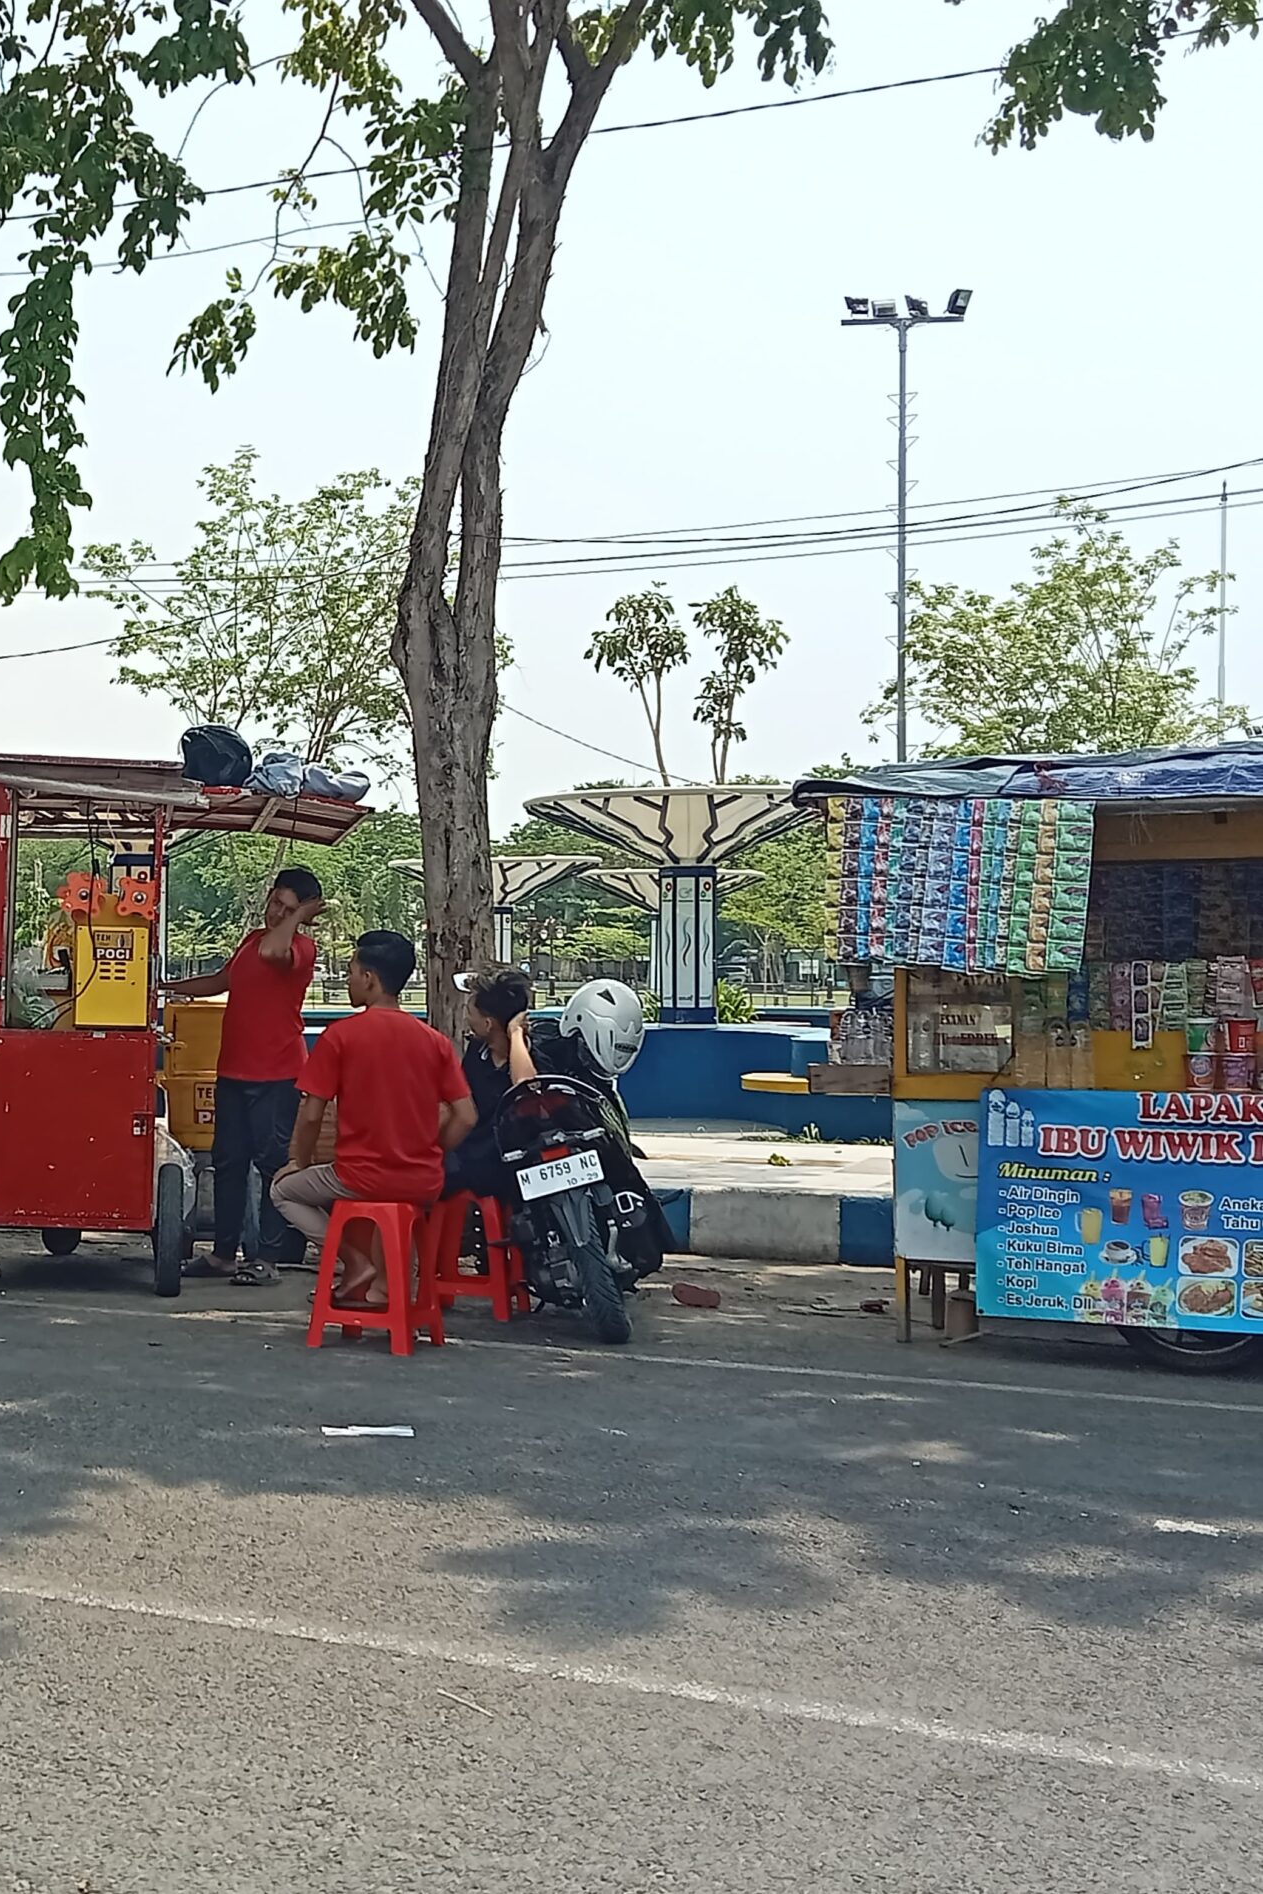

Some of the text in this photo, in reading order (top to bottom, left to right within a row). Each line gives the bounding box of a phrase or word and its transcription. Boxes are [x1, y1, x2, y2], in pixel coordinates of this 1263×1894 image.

[96, 933, 111, 942] TEH
[96, 948, 130, 960] POCI
[197, 1086, 216, 1099] TE
[1138, 1091, 1263, 1123] LAPAK
[1038, 1124, 1108, 1158] IBU
[1114, 1127, 1245, 1164] WIWIK
[520, 1154, 598, 1186] M 6759 NC
[998, 1162, 1097, 1182] Minuman
[1007, 1185, 1080, 1204] Air Dingin
[1007, 1203, 1061, 1219] Pop Ice
[1006, 1222, 1059, 1237] Joshua
[1221, 1214, 1261, 1231] Tahu
[1006, 1239, 1083, 1256] Kuku Bima
[1005, 1257, 1086, 1275] Teh Hangat
[1006, 1275, 1037, 1290] Kopi
[1006, 1293, 1022, 1306] Es
